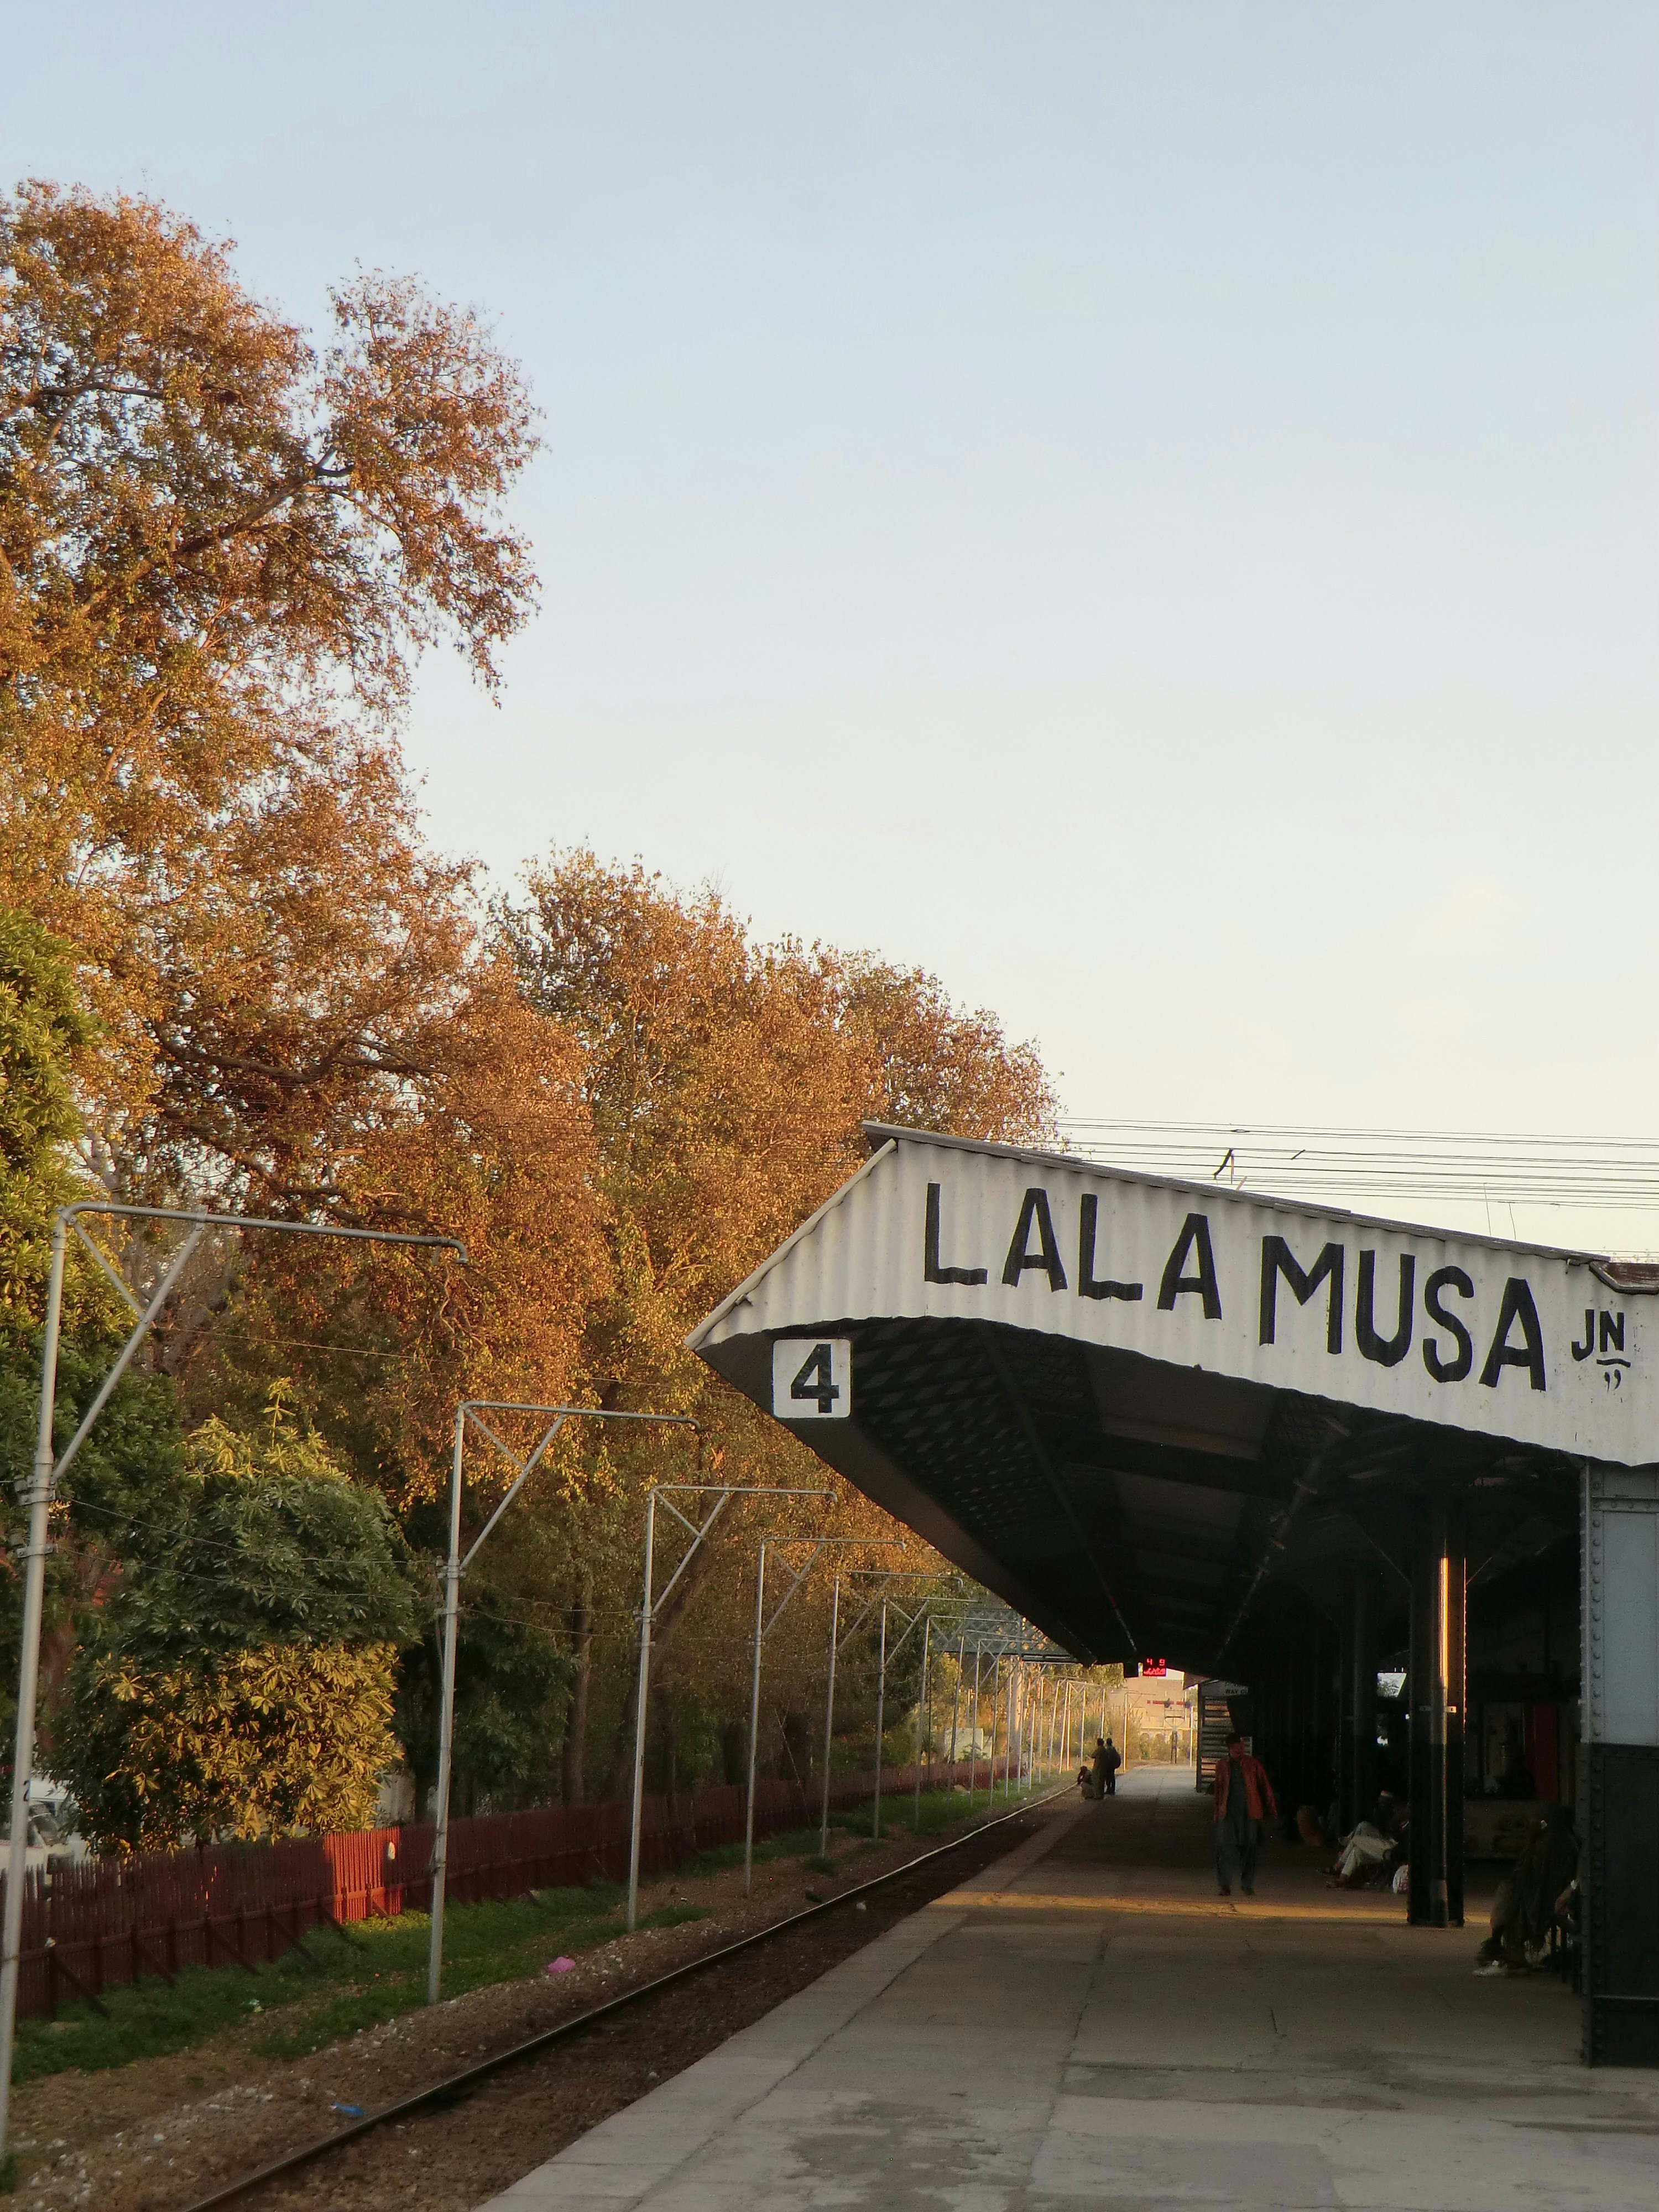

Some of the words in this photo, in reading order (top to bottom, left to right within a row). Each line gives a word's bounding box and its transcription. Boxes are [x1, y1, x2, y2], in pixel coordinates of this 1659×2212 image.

[924, 1182, 1222, 1321] LALA
[1259, 1235, 1546, 1392] MUSA
[790, 1343, 839, 1413] 4
[1146, 1657, 1153, 1666] 4
